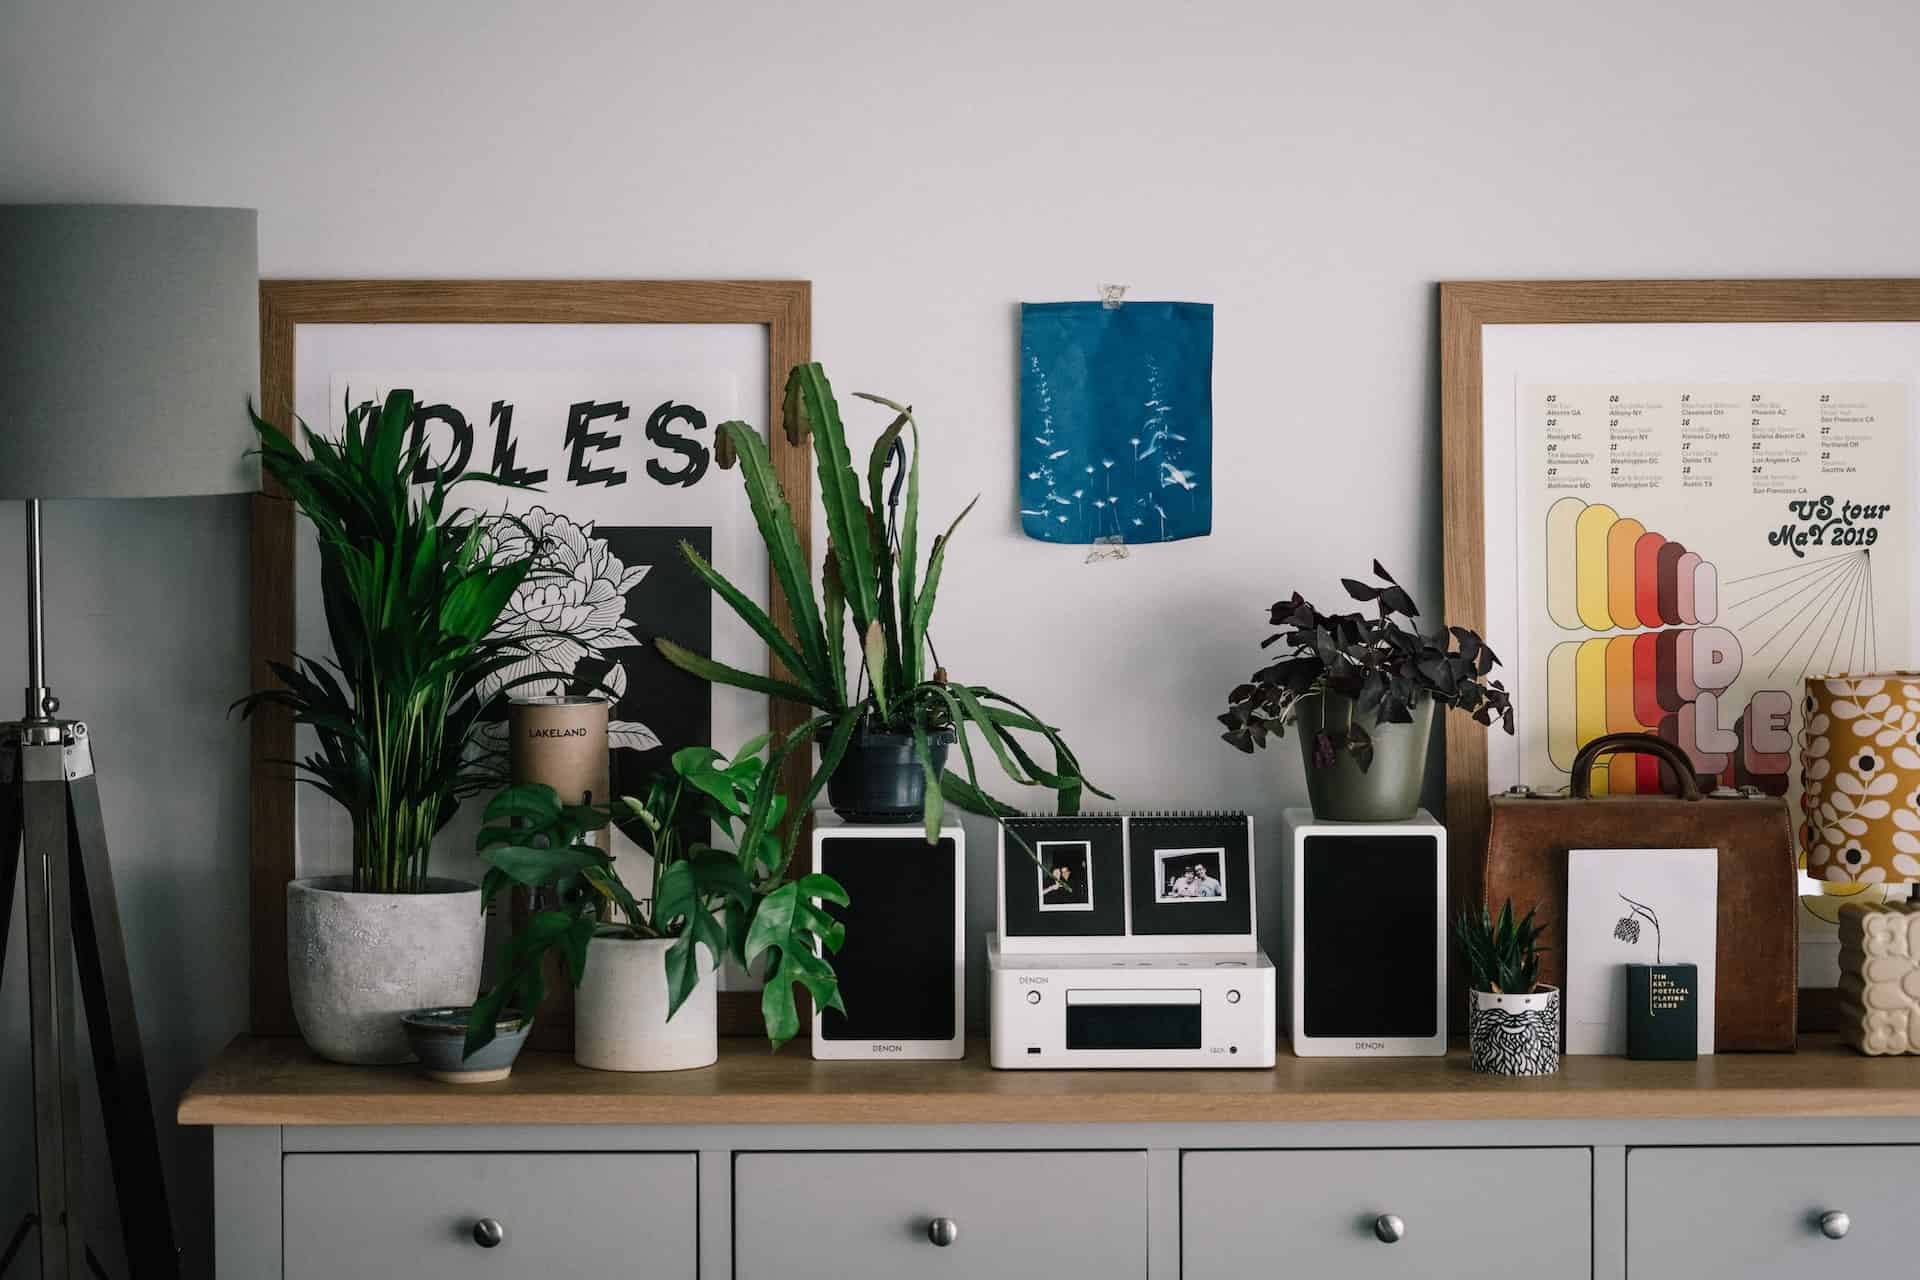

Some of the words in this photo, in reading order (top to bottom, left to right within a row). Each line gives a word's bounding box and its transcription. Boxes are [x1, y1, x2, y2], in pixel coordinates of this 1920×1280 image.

[1789, 495, 1834, 521] US
[1842, 500, 1890, 526] tour
[1831, 527, 1878, 546] 2019
[528, 728, 586, 738] LAKELAND
[1018, 976, 1048, 984] DENON
[872, 1044, 902, 1052] DENON
